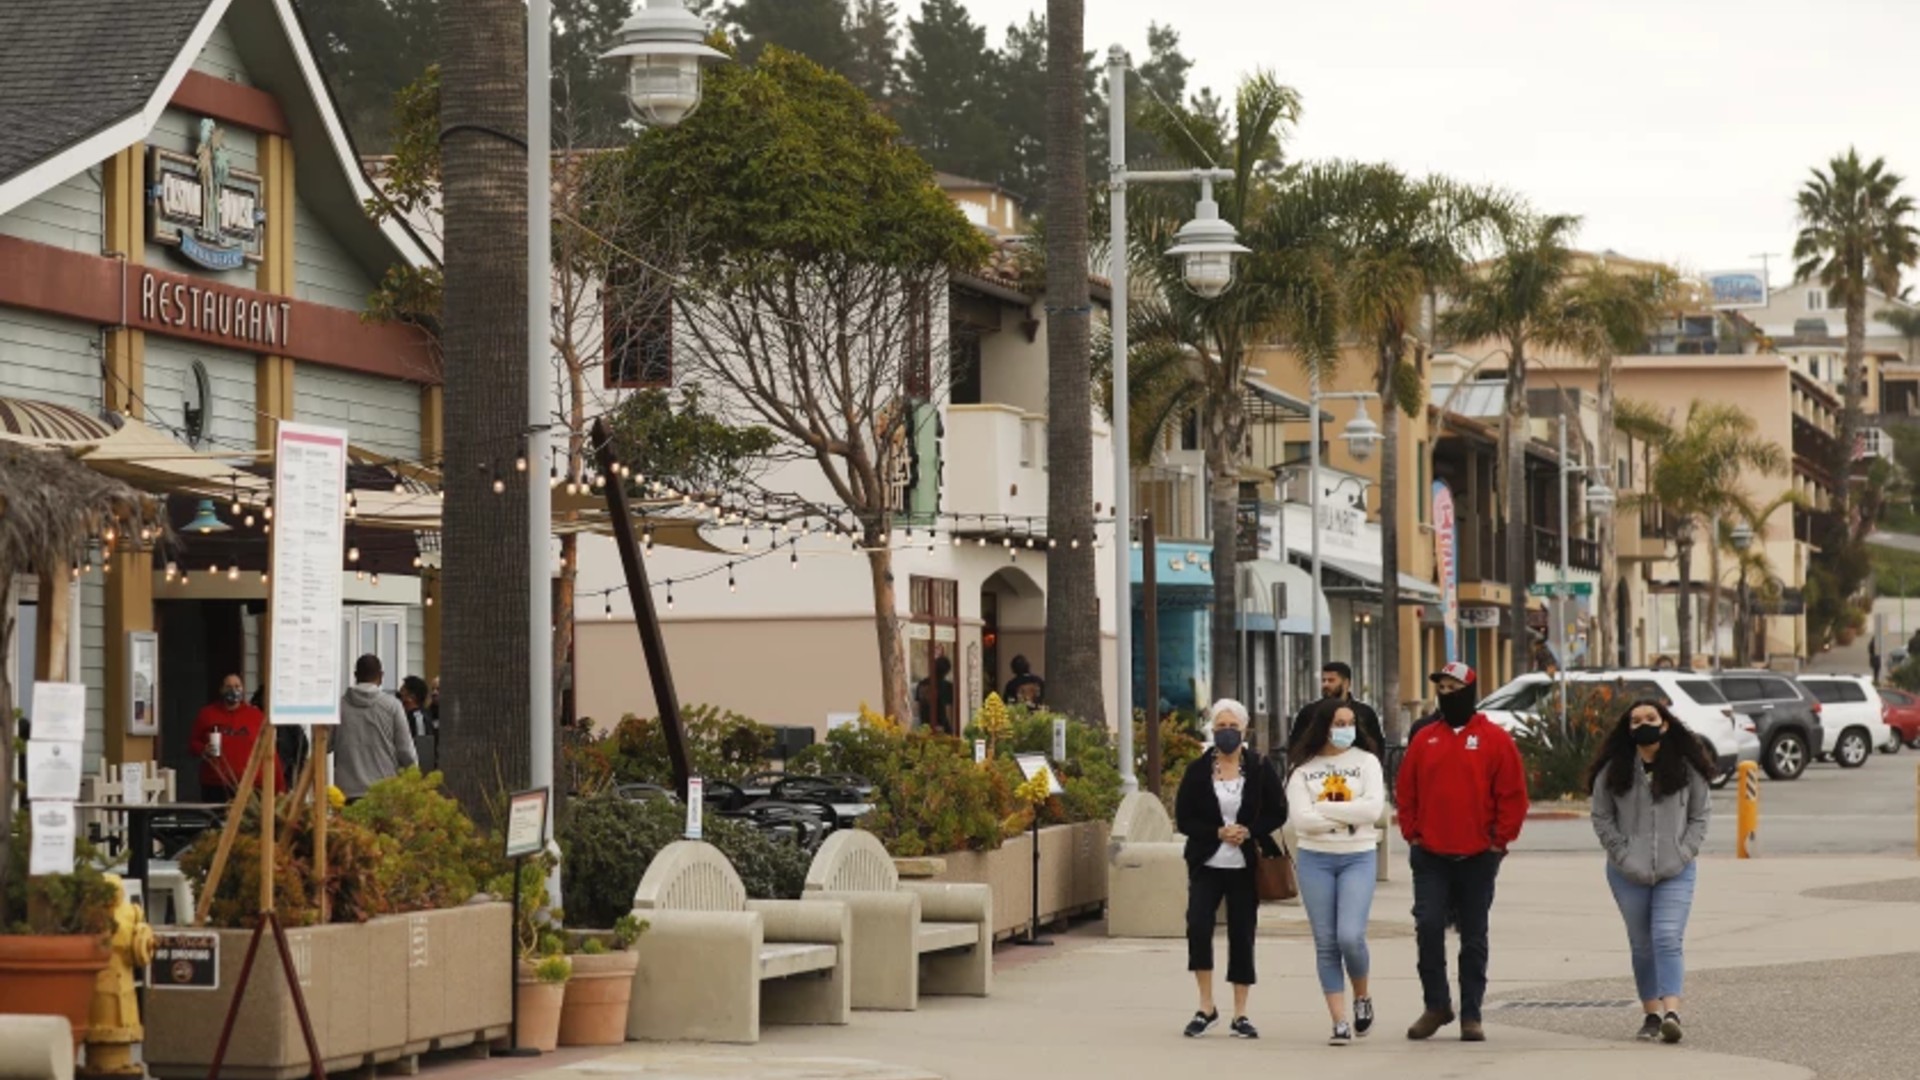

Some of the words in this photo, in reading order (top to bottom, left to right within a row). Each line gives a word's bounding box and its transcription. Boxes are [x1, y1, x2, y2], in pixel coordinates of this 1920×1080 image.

[143, 273, 291, 346] RESTAURANT
[155, 949, 169, 960] NO
[171, 949, 210, 960] SMOKING
